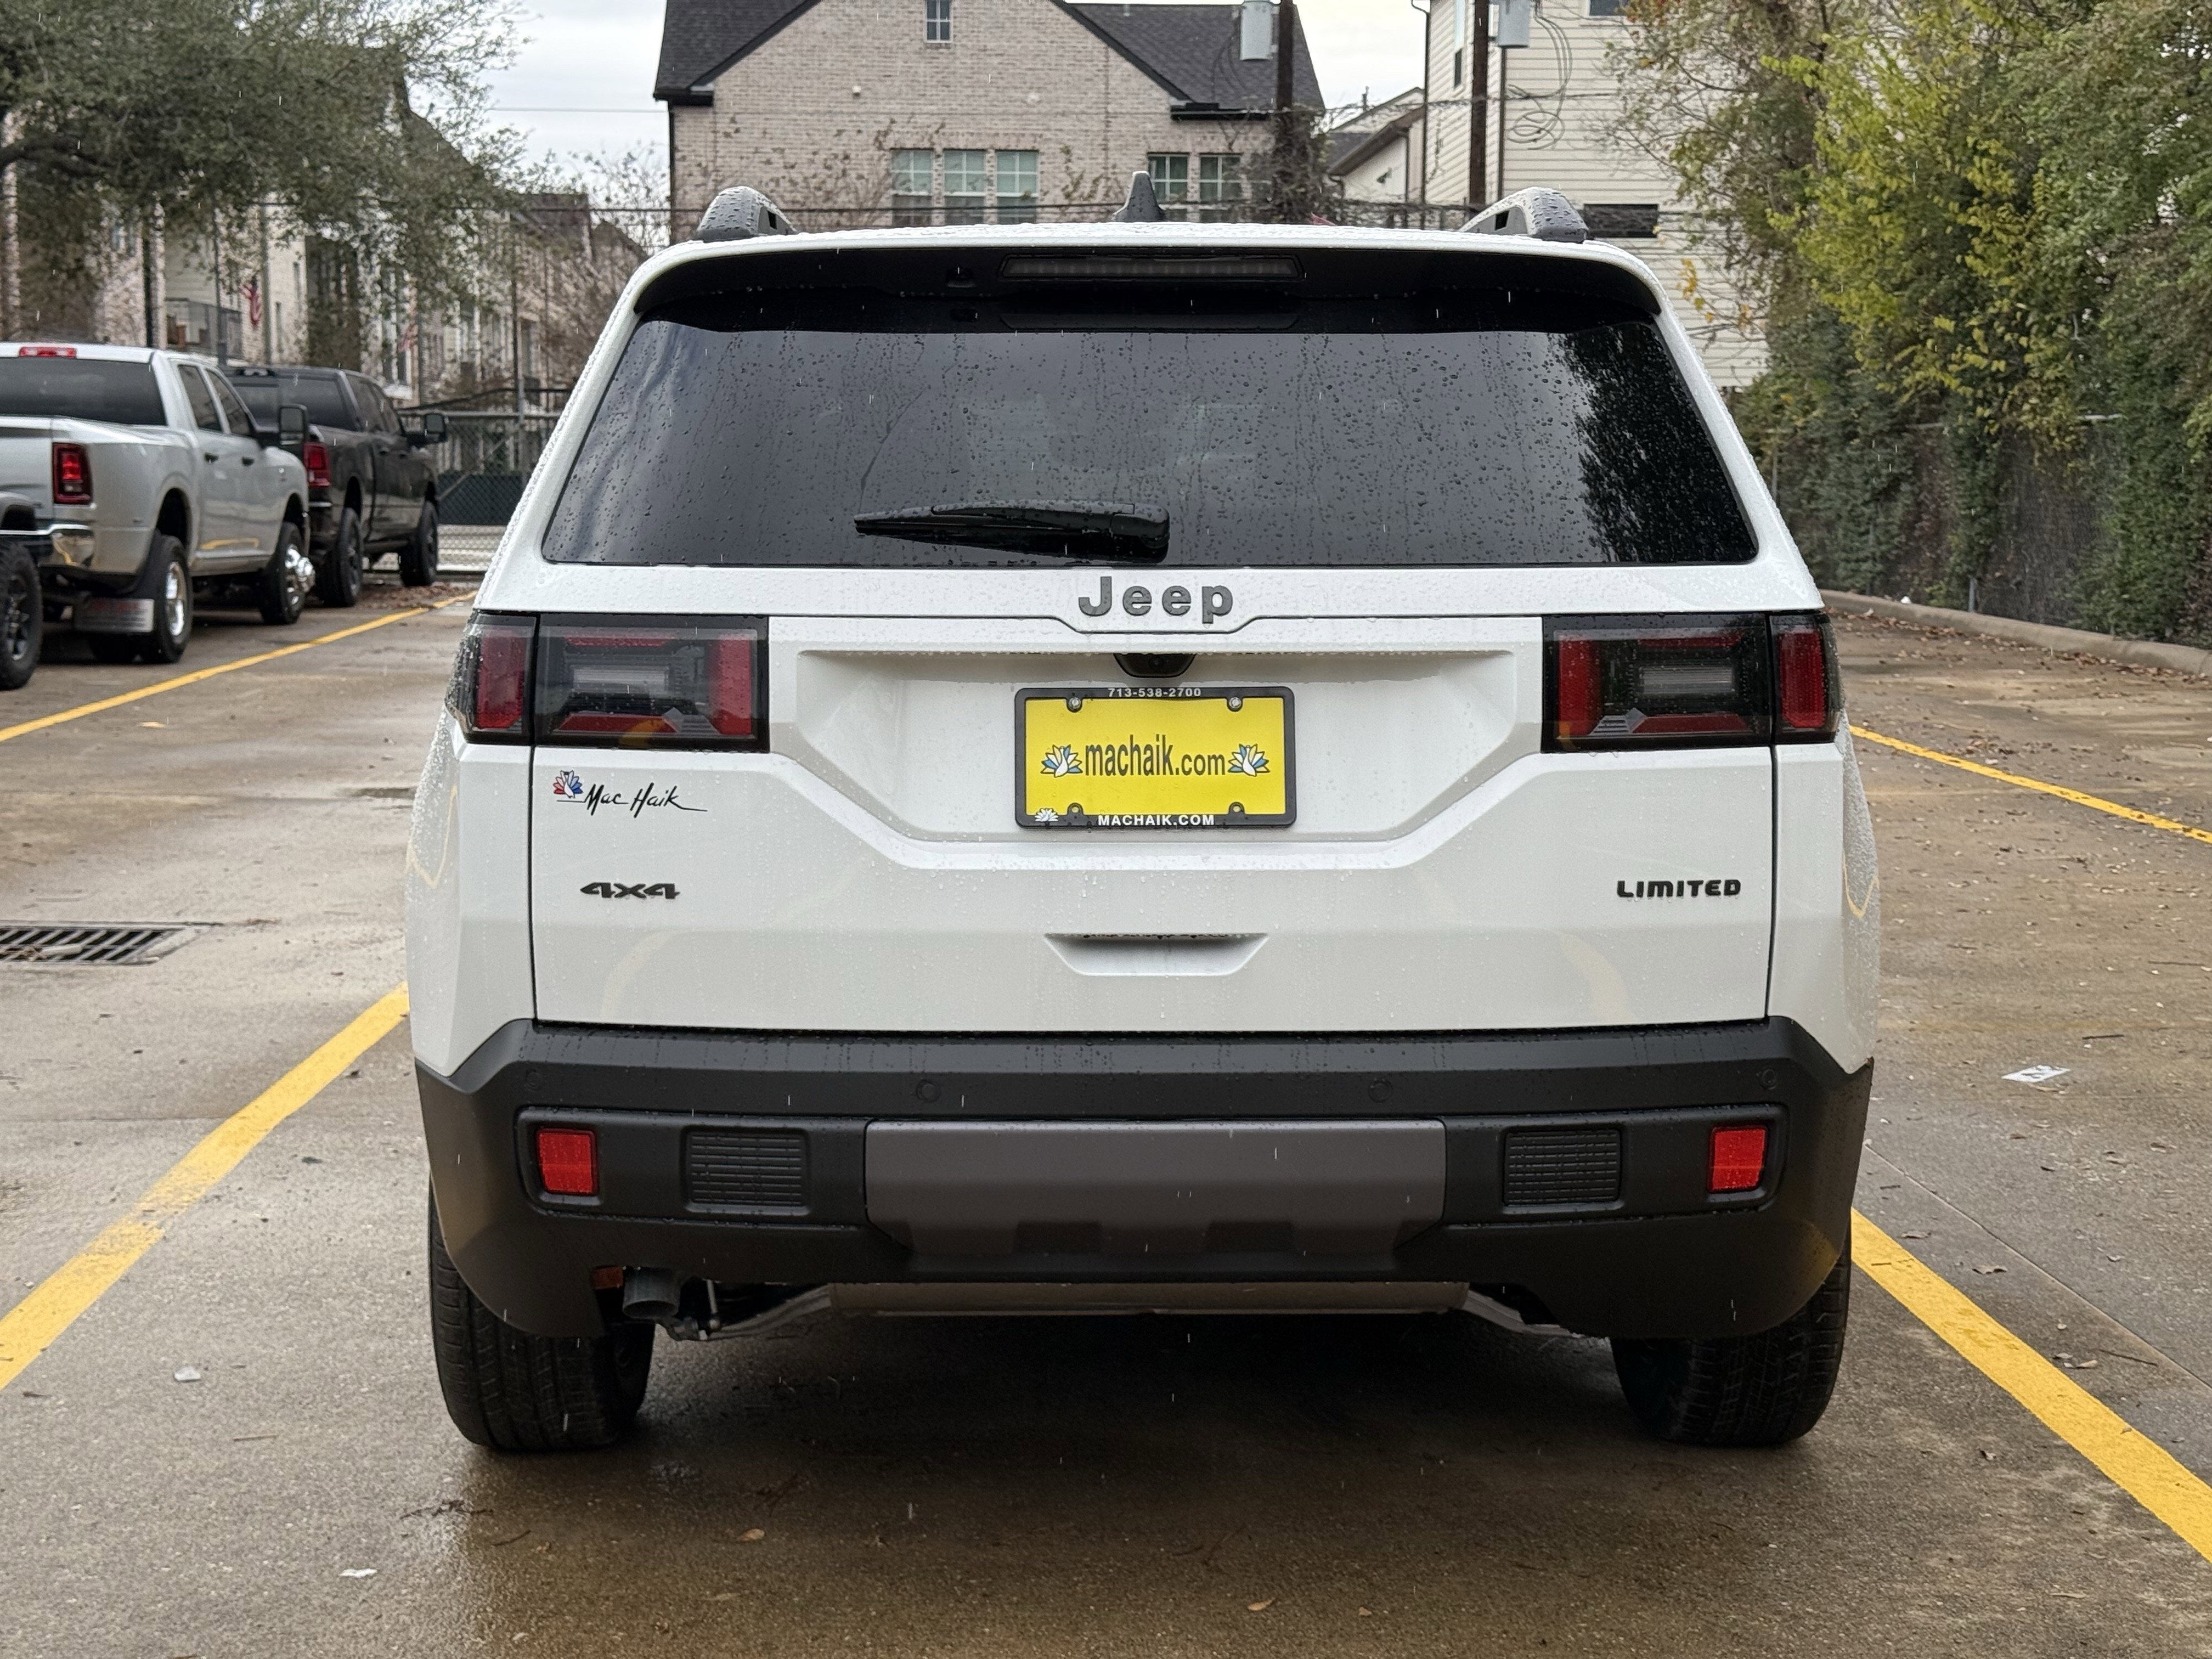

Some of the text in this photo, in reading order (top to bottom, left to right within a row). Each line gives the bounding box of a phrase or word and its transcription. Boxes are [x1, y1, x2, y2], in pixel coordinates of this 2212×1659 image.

[1078, 575, 1233, 624] Jeep
[1108, 688, 1201, 697] 713-538-2700
[1085, 734, 1226, 776] machaik.com
[584, 782, 708, 819] Mac Haik
[1098, 814, 1215, 826] MACHAIK.COM
[1617, 879, 1741, 898] LIMITED
